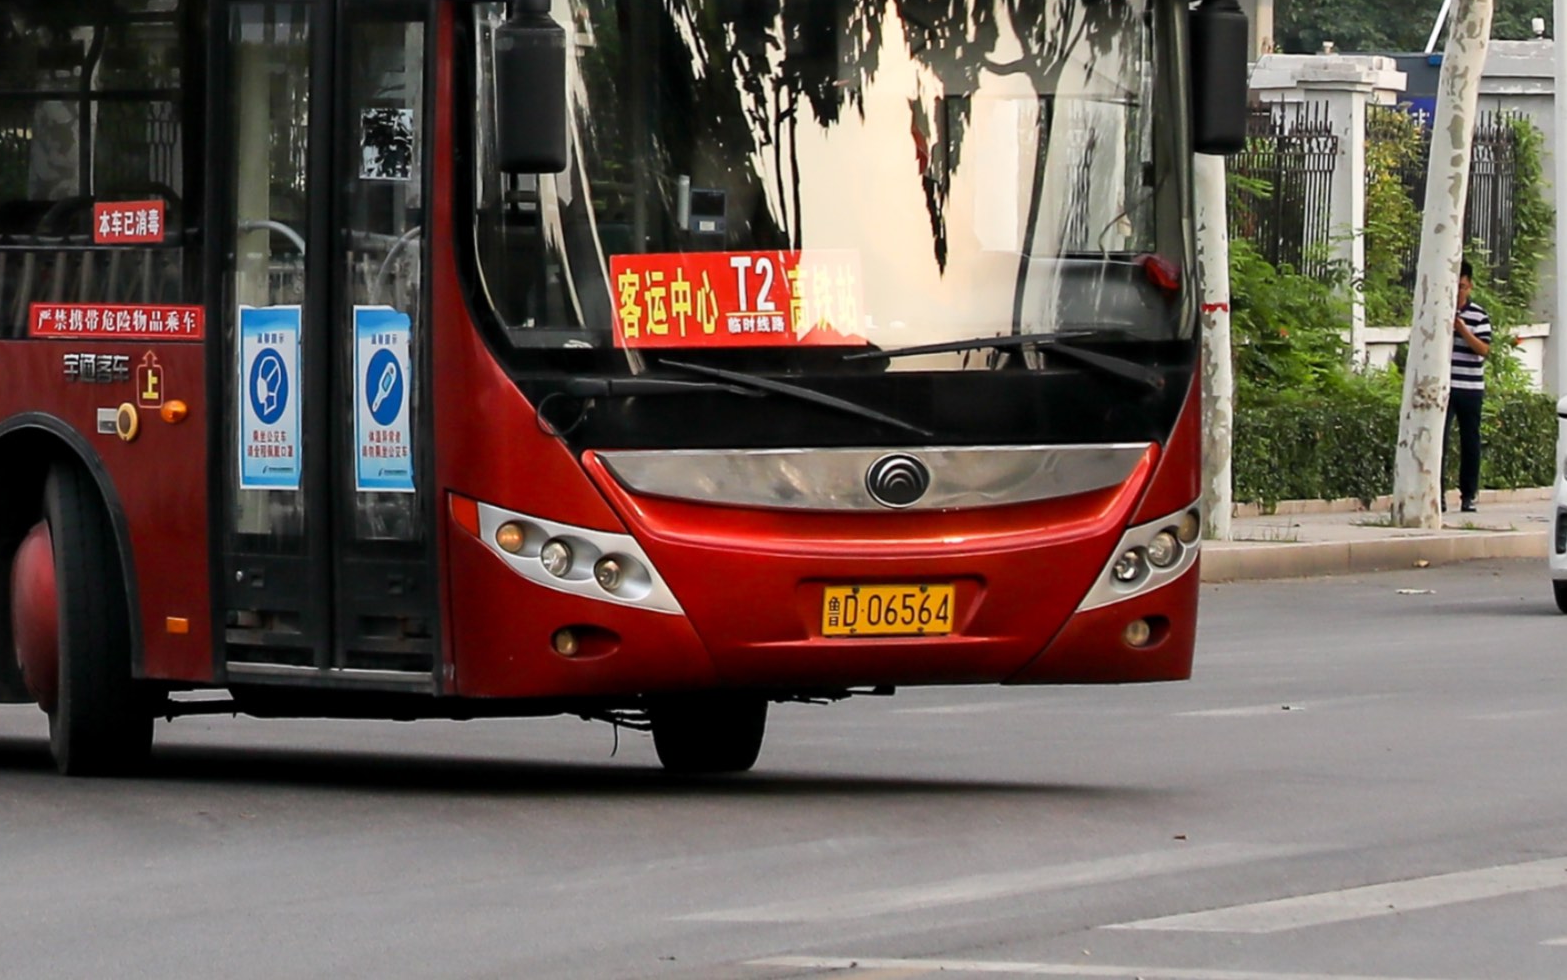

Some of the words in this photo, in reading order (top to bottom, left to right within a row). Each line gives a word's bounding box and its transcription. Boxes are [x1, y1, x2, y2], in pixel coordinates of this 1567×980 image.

[99, 209, 160, 237] 本车已消毒
[618, 268, 719, 339] 客运中心
[730, 256, 775, 312] T2
[37, 308, 196, 333] 严禁携带危险物品乘车
[728, 316, 785, 334] 临时线路
[142, 369, 159, 400] 上
